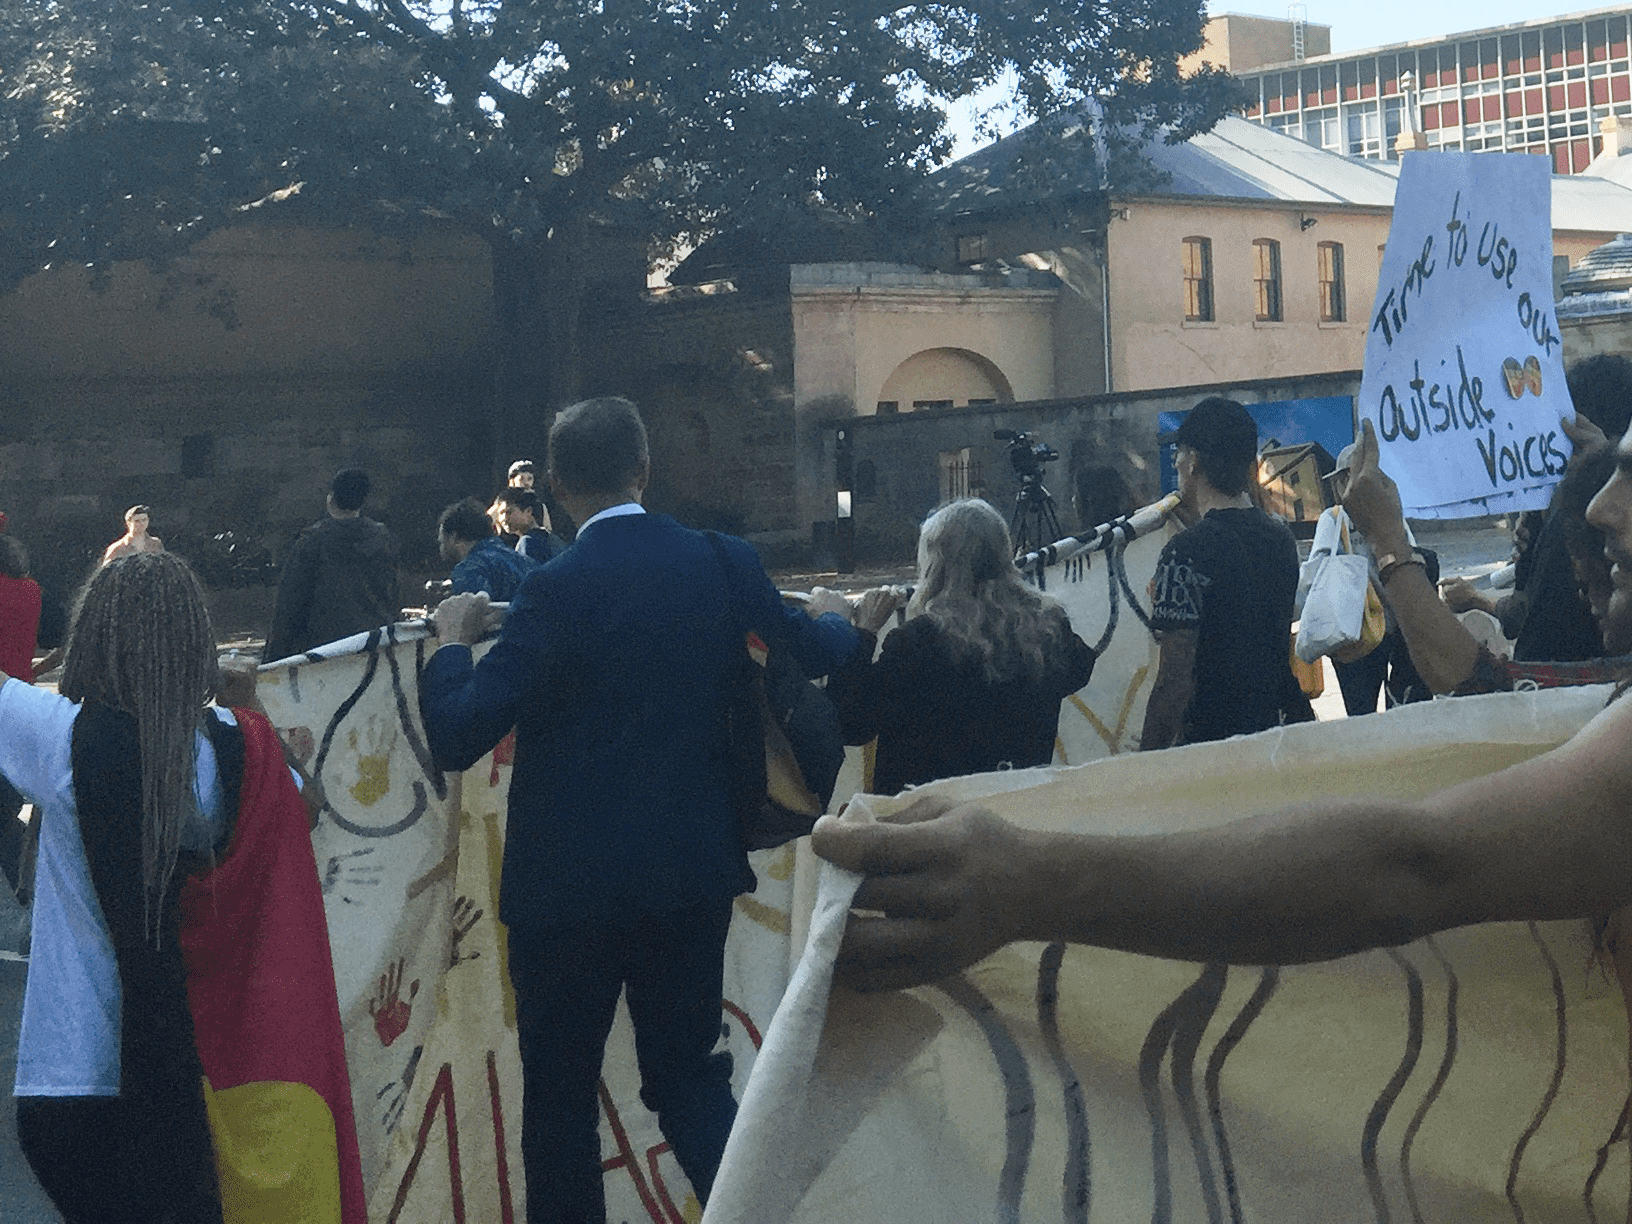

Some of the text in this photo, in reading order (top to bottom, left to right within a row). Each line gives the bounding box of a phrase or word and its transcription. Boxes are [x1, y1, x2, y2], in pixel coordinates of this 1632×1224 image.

[1373, 235, 1435, 346] Time
[1446, 191, 1468, 270] to
[1379, 345, 1495, 443] Outside
[1475, 422, 1568, 488] Voices
